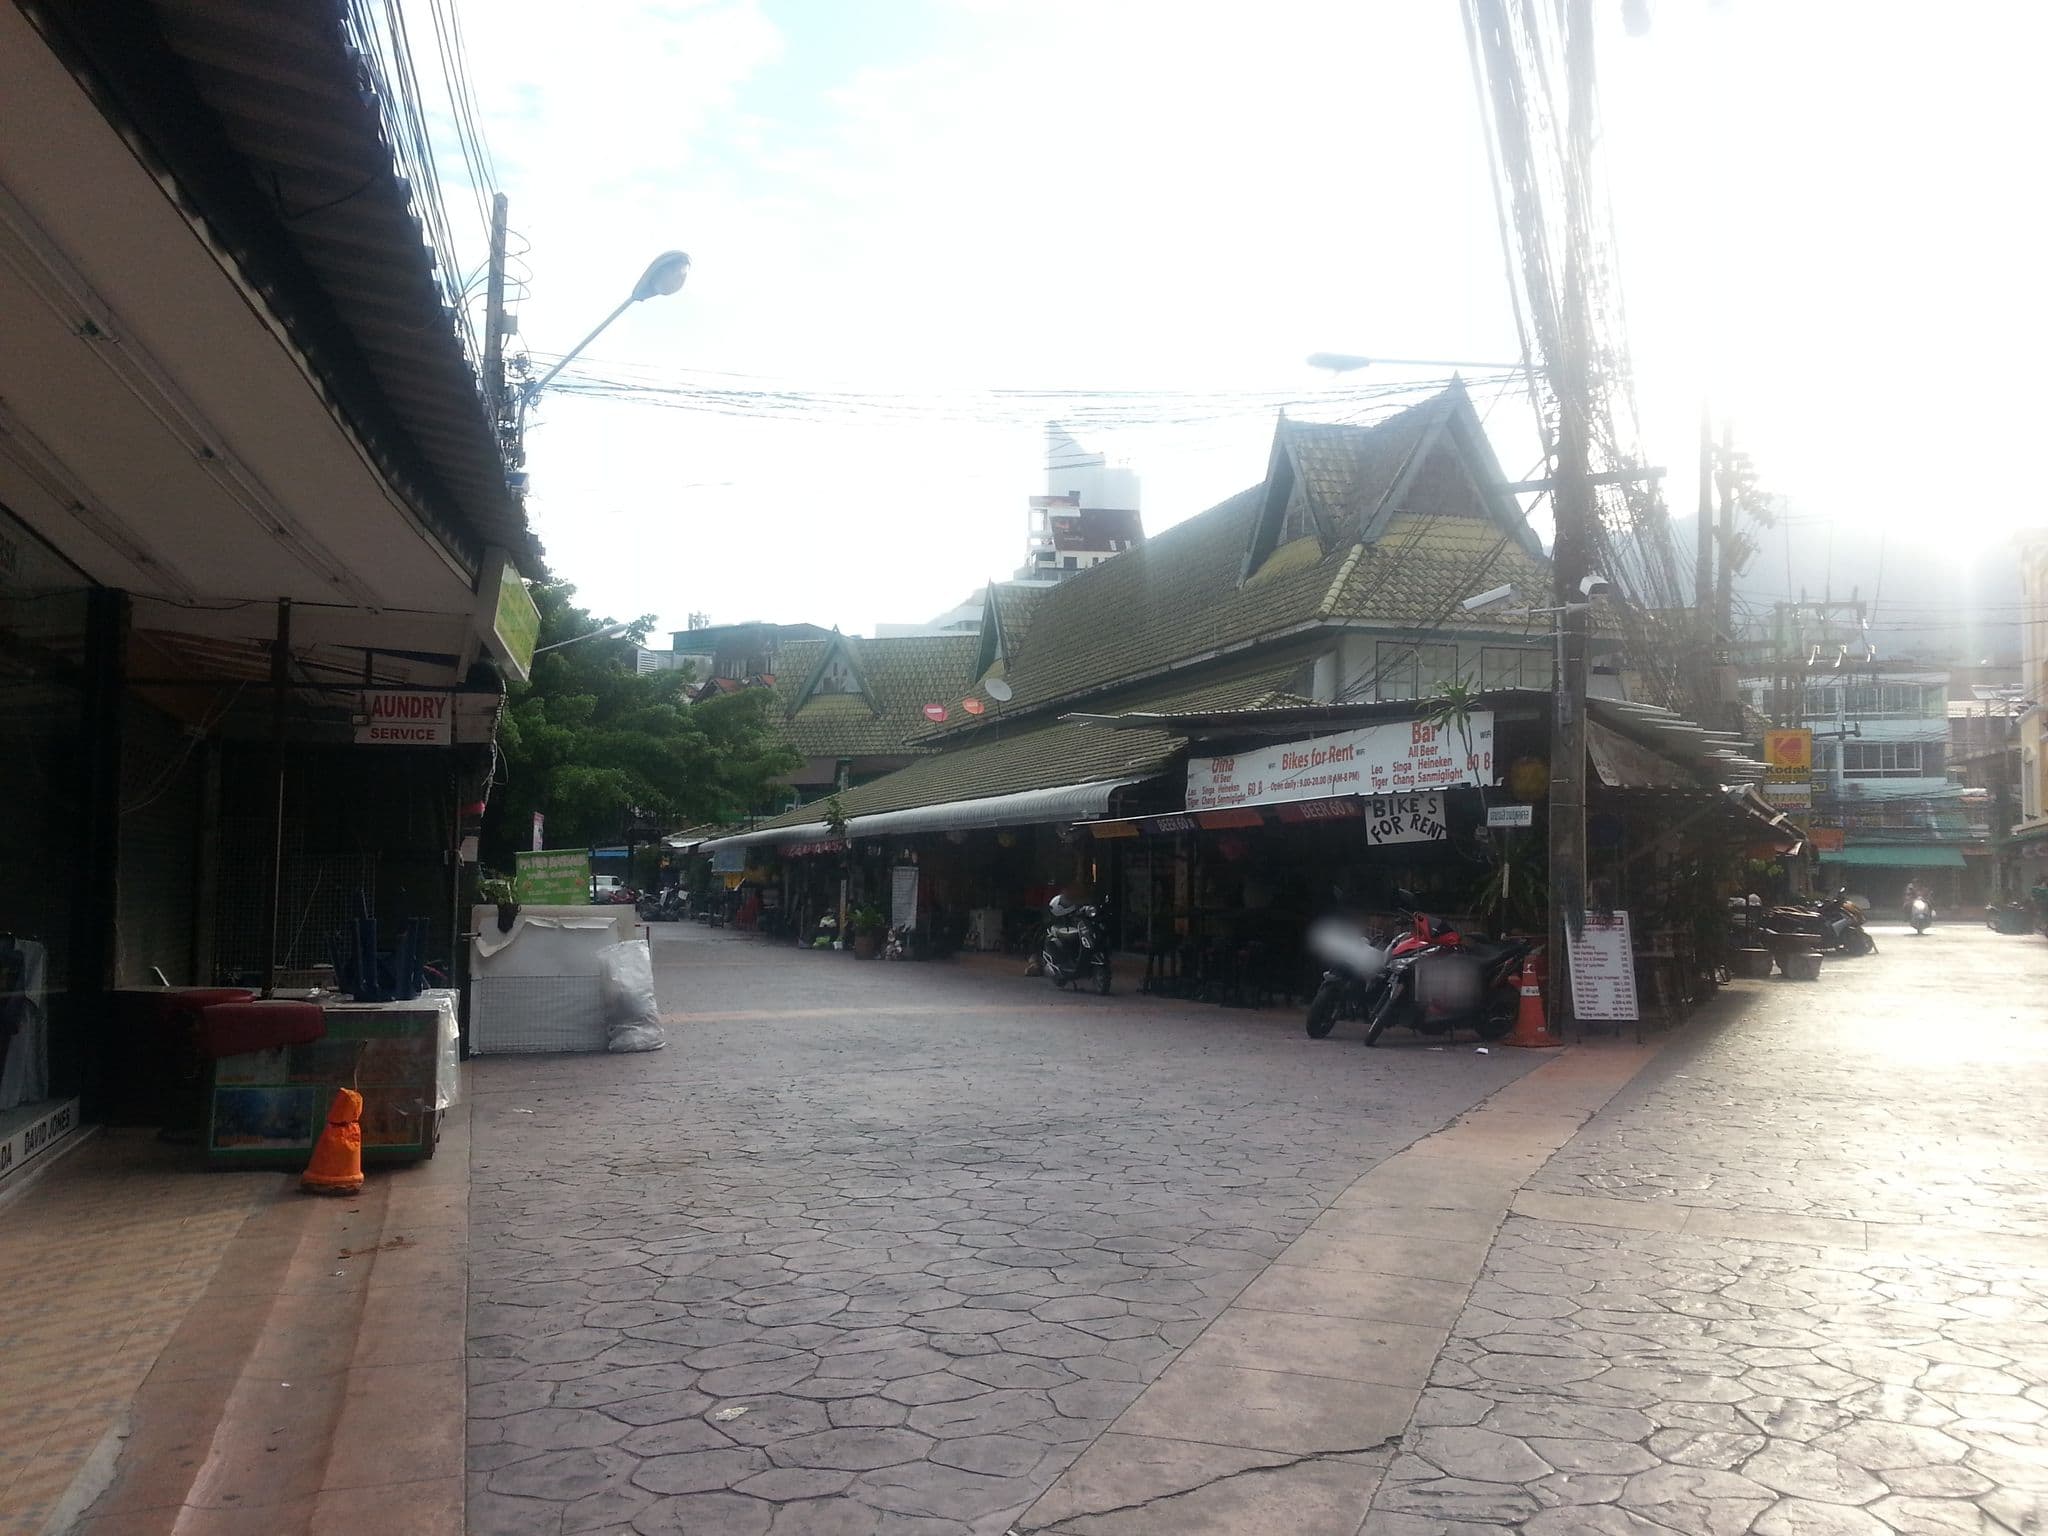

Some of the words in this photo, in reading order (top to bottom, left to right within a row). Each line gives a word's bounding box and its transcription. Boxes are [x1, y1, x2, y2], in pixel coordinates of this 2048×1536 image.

[370, 727, 436, 740] SERVICE
[1412, 721, 1437, 744] Bar
[1282, 752, 1309, 770] Bikes
[1311, 748, 1326, 767] for
[1329, 744, 1354, 763] Rent
[1408, 746, 1418, 758] All
[1420, 745, 1438, 757] Beer
[1371, 764, 1383, 775] Leo
[1392, 761, 1412, 774] Singa
[1418, 756, 1453, 769] Heineken
[1765, 764, 1809, 774] Kodak
[1270, 782, 1284, 792] Open
[1371, 777, 1388, 789] Tiger
[1392, 774, 1415, 786] Chang
[1418, 768, 1463, 783] Sanmiglight
[1301, 801, 1330, 818] BEER
[1157, 817, 1177, 832] BEER
[1371, 816, 1404, 843] FOR
[1410, 814, 1446, 840] RENT
[24, 1121, 47, 1155] DAVID
[48, 1107, 70, 1140] JONES
